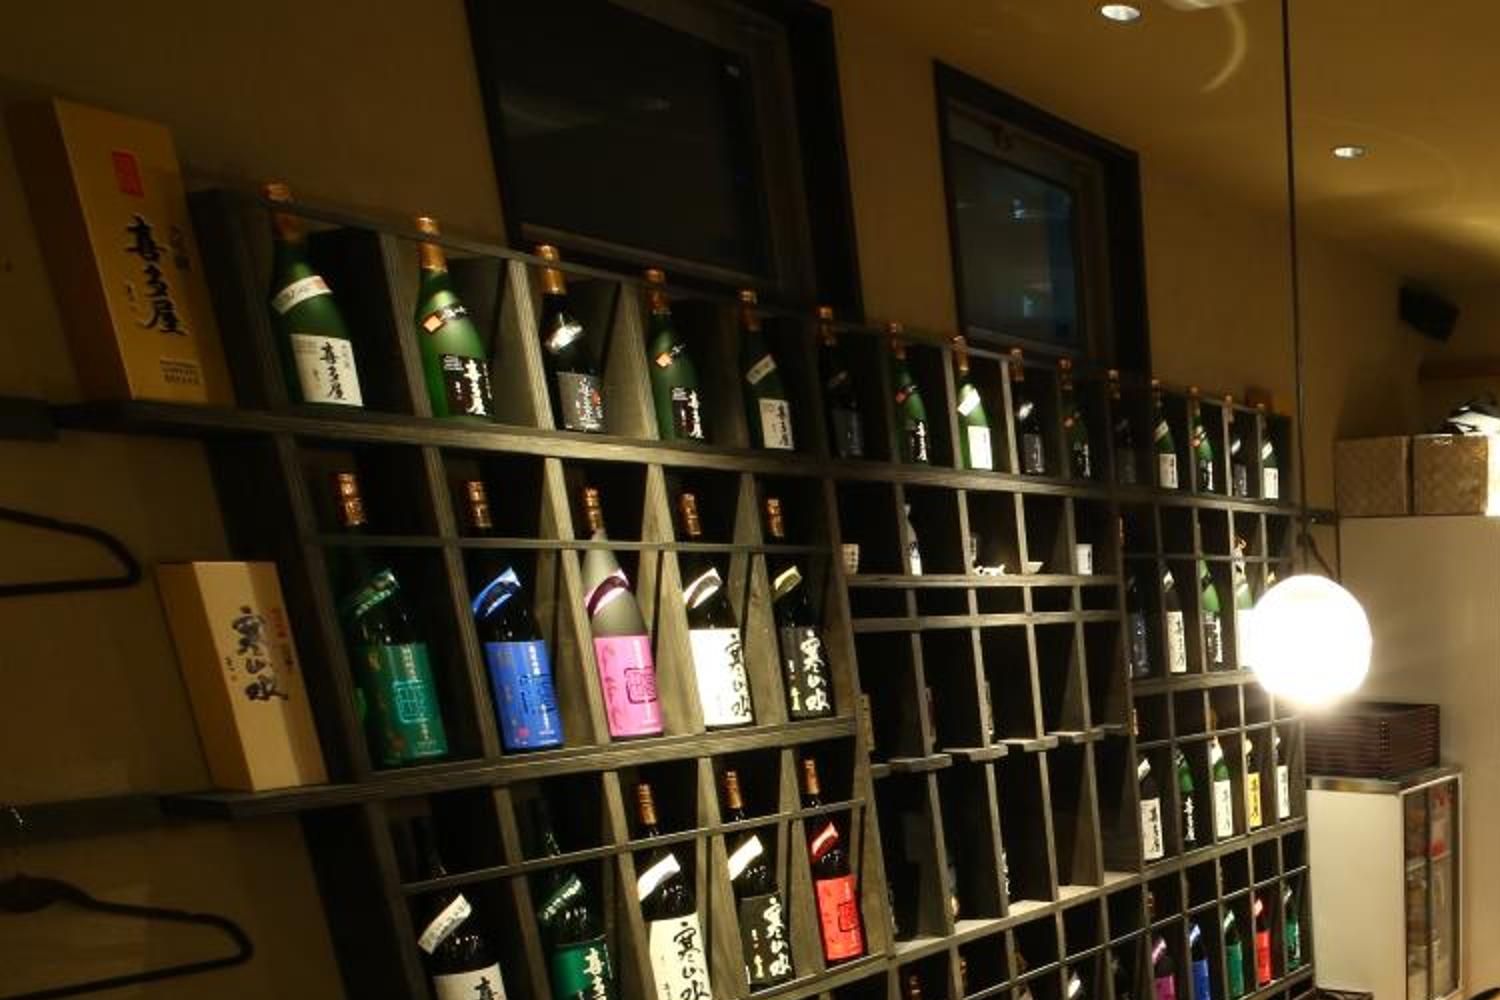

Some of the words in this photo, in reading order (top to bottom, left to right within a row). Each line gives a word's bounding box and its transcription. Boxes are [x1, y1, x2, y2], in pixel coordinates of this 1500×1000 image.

[125, 213, 189, 337] 喜多屋
[319, 341, 347, 401] 喜多屋
